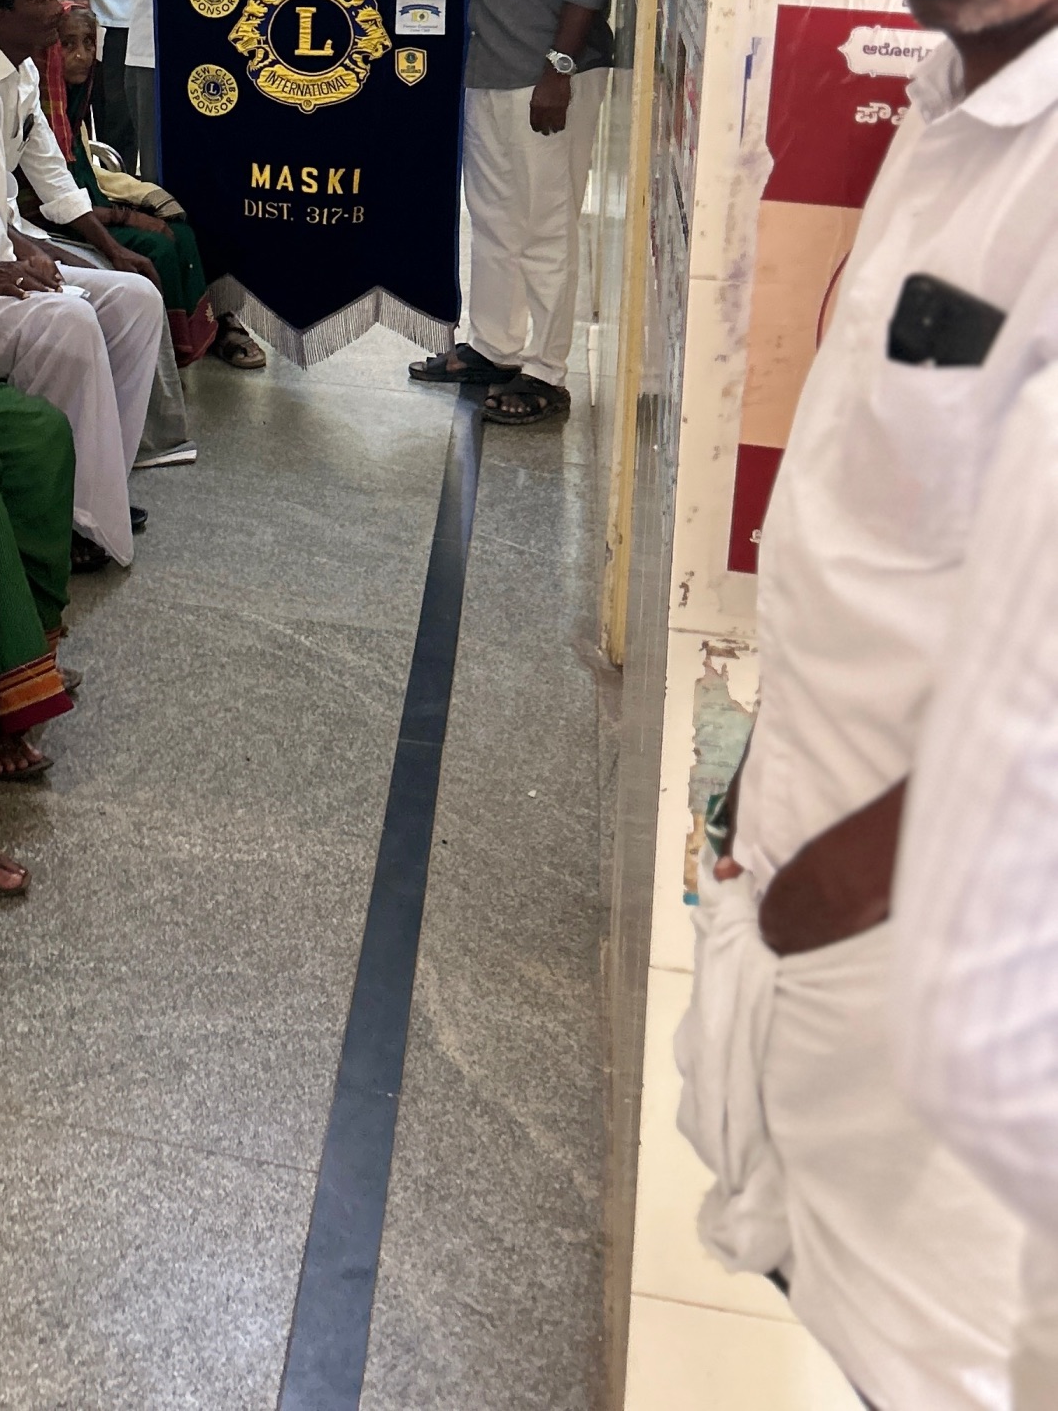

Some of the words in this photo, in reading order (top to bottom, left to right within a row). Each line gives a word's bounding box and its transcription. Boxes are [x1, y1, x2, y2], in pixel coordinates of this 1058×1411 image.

[294, 6, 334, 57] L
[191, 67, 210, 84] NEW
[215, 69, 236, 92] CLUB
[266, 71, 351, 98] INTERNATIONAL
[190, 89, 234, 114] SPONSOR
[251, 162, 362, 195] MASKI
[245, 199, 294, 222] DIST.
[306, 206, 365, 225] 317-B
